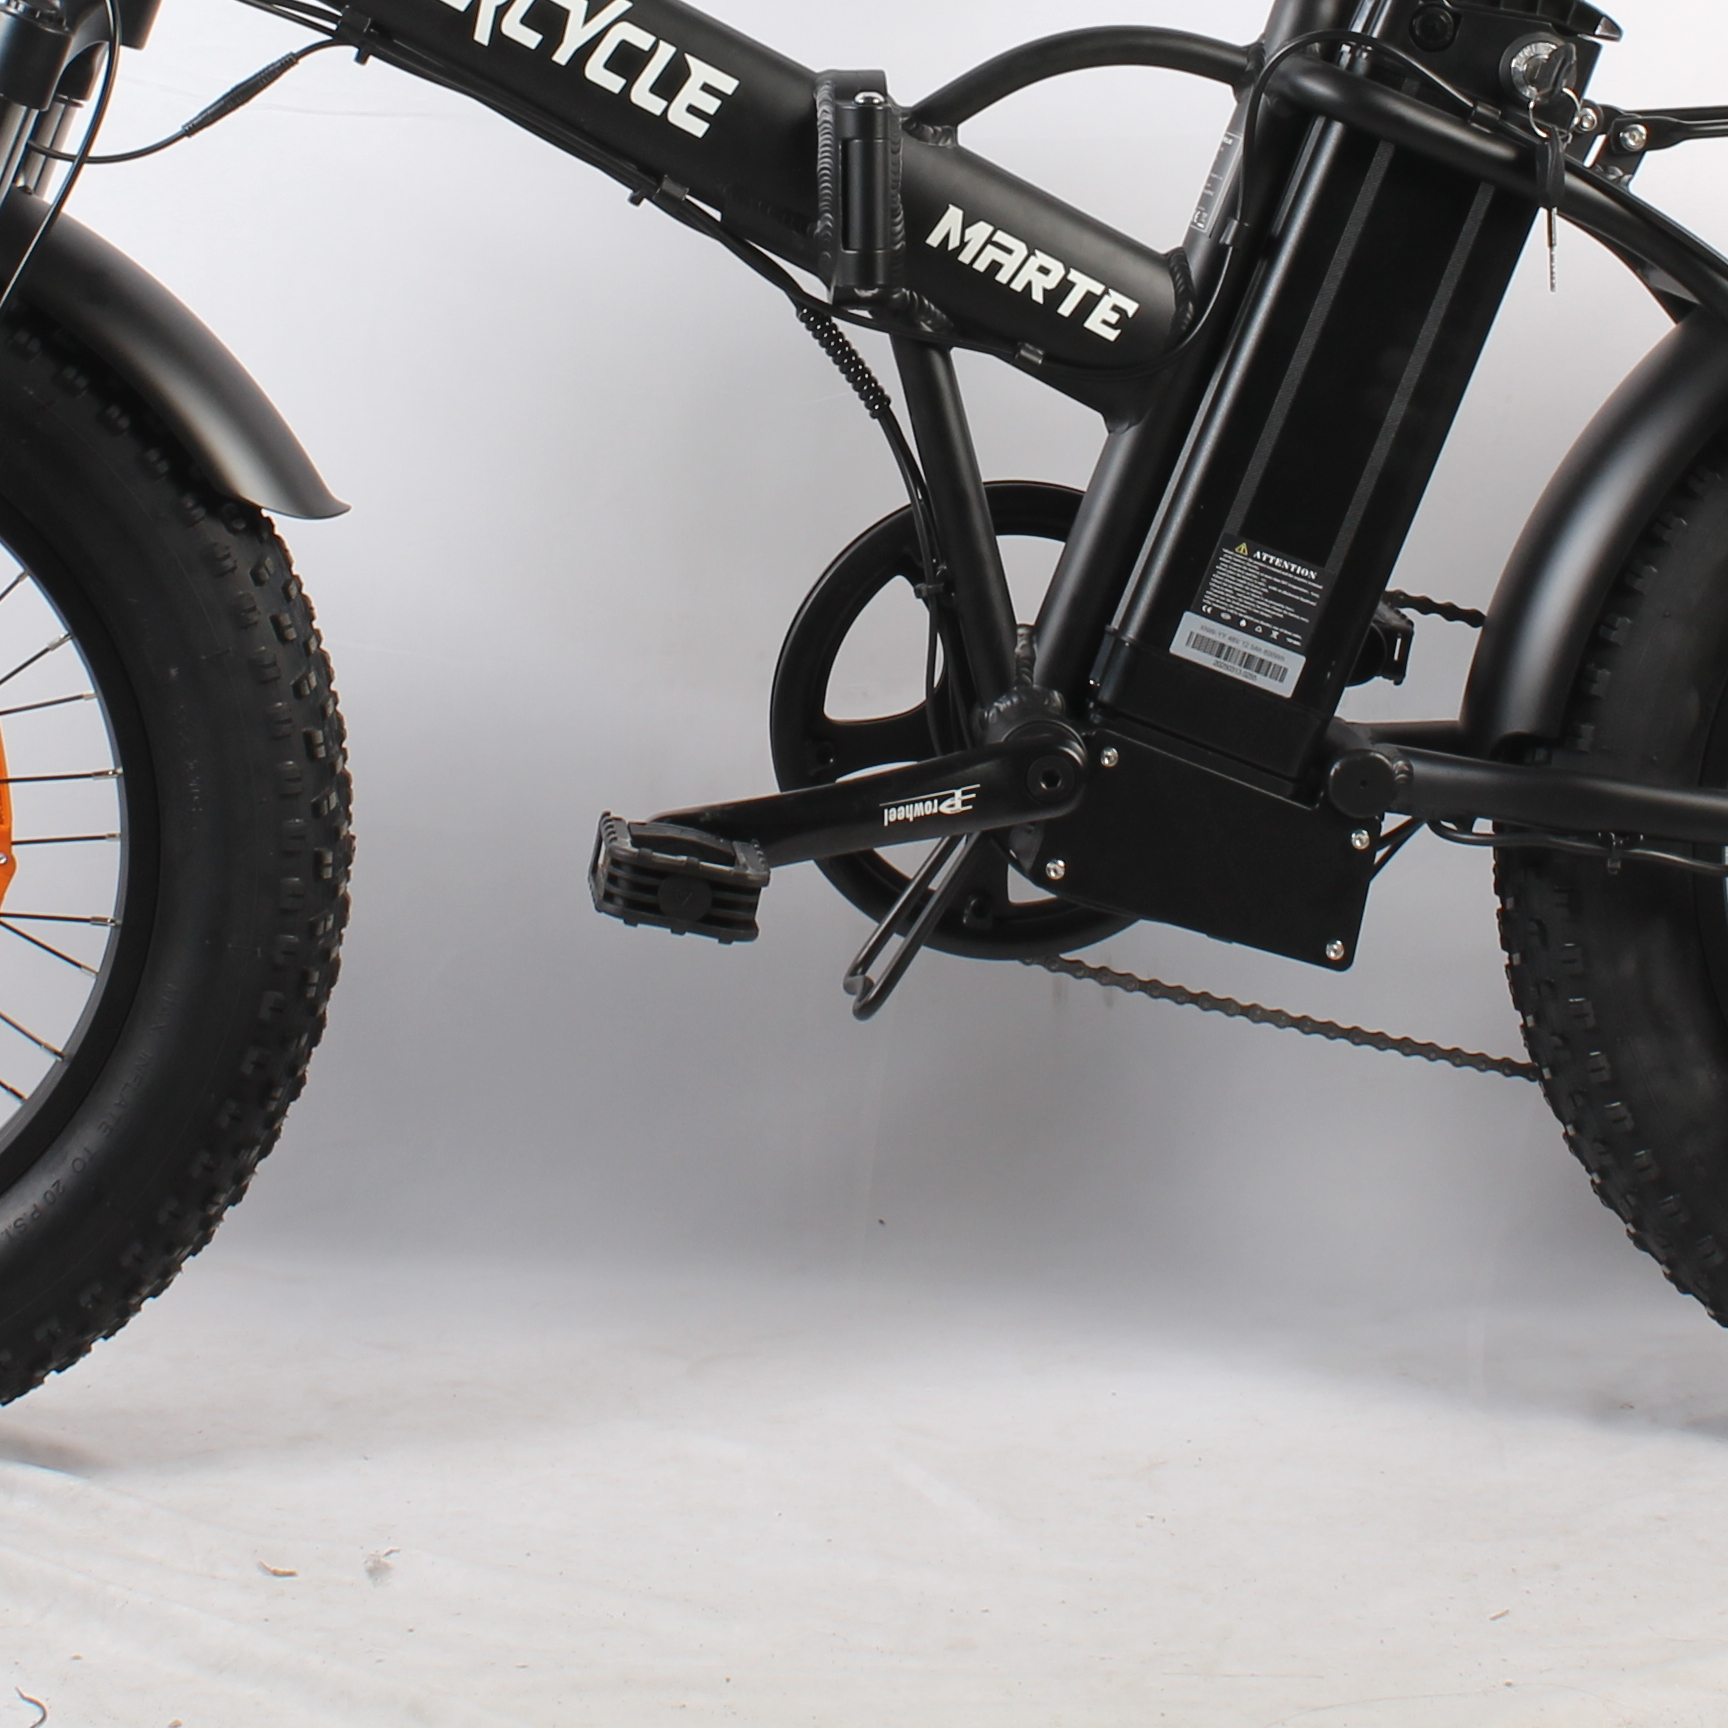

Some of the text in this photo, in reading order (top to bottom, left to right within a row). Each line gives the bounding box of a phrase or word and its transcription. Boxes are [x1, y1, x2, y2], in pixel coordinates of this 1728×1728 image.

[926, 205, 1139, 341] MARTE
[1252, 550, 1318, 580] ATTENTION
[881, 785, 978, 826] Prowheel
